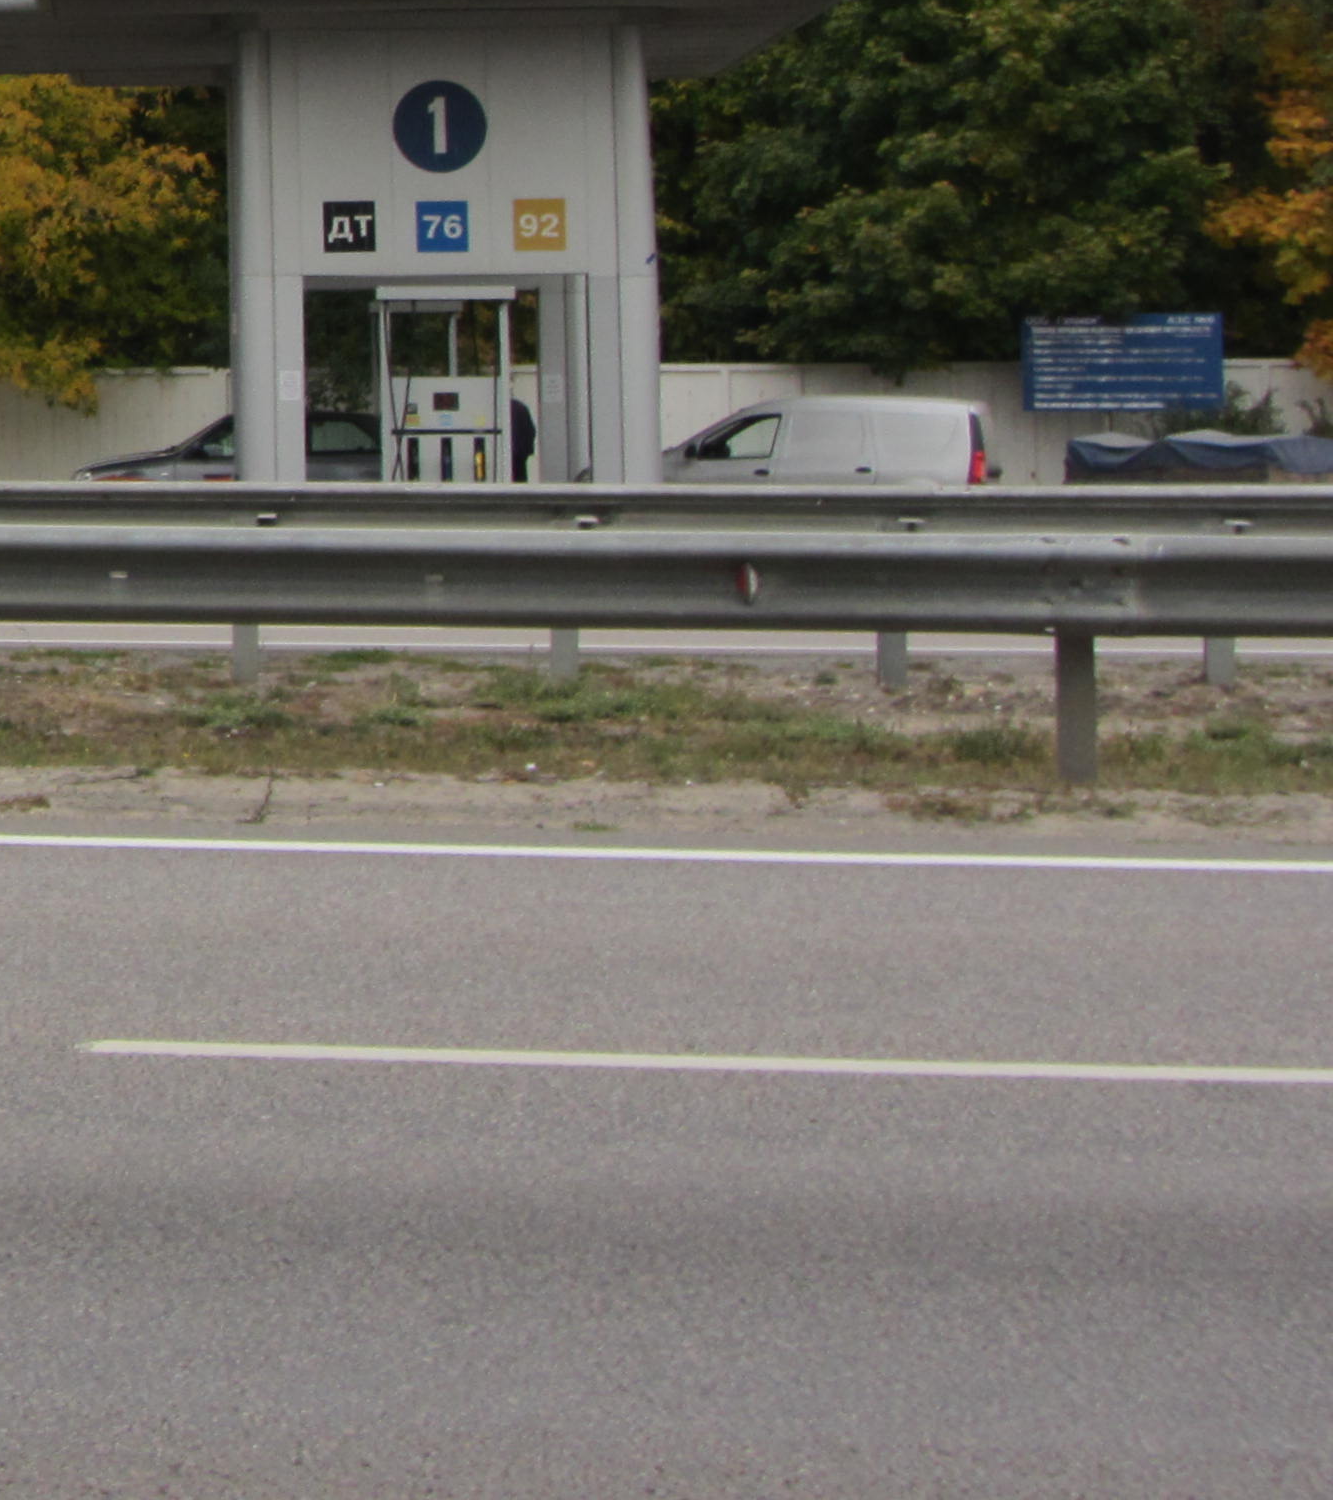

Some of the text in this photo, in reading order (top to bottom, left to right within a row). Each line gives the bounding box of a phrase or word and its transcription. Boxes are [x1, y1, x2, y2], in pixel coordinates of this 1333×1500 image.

[427, 96, 448, 154] 1
[328, 215, 372, 243] ДТ
[422, 215, 463, 239] 76
[519, 213, 559, 238] 92
